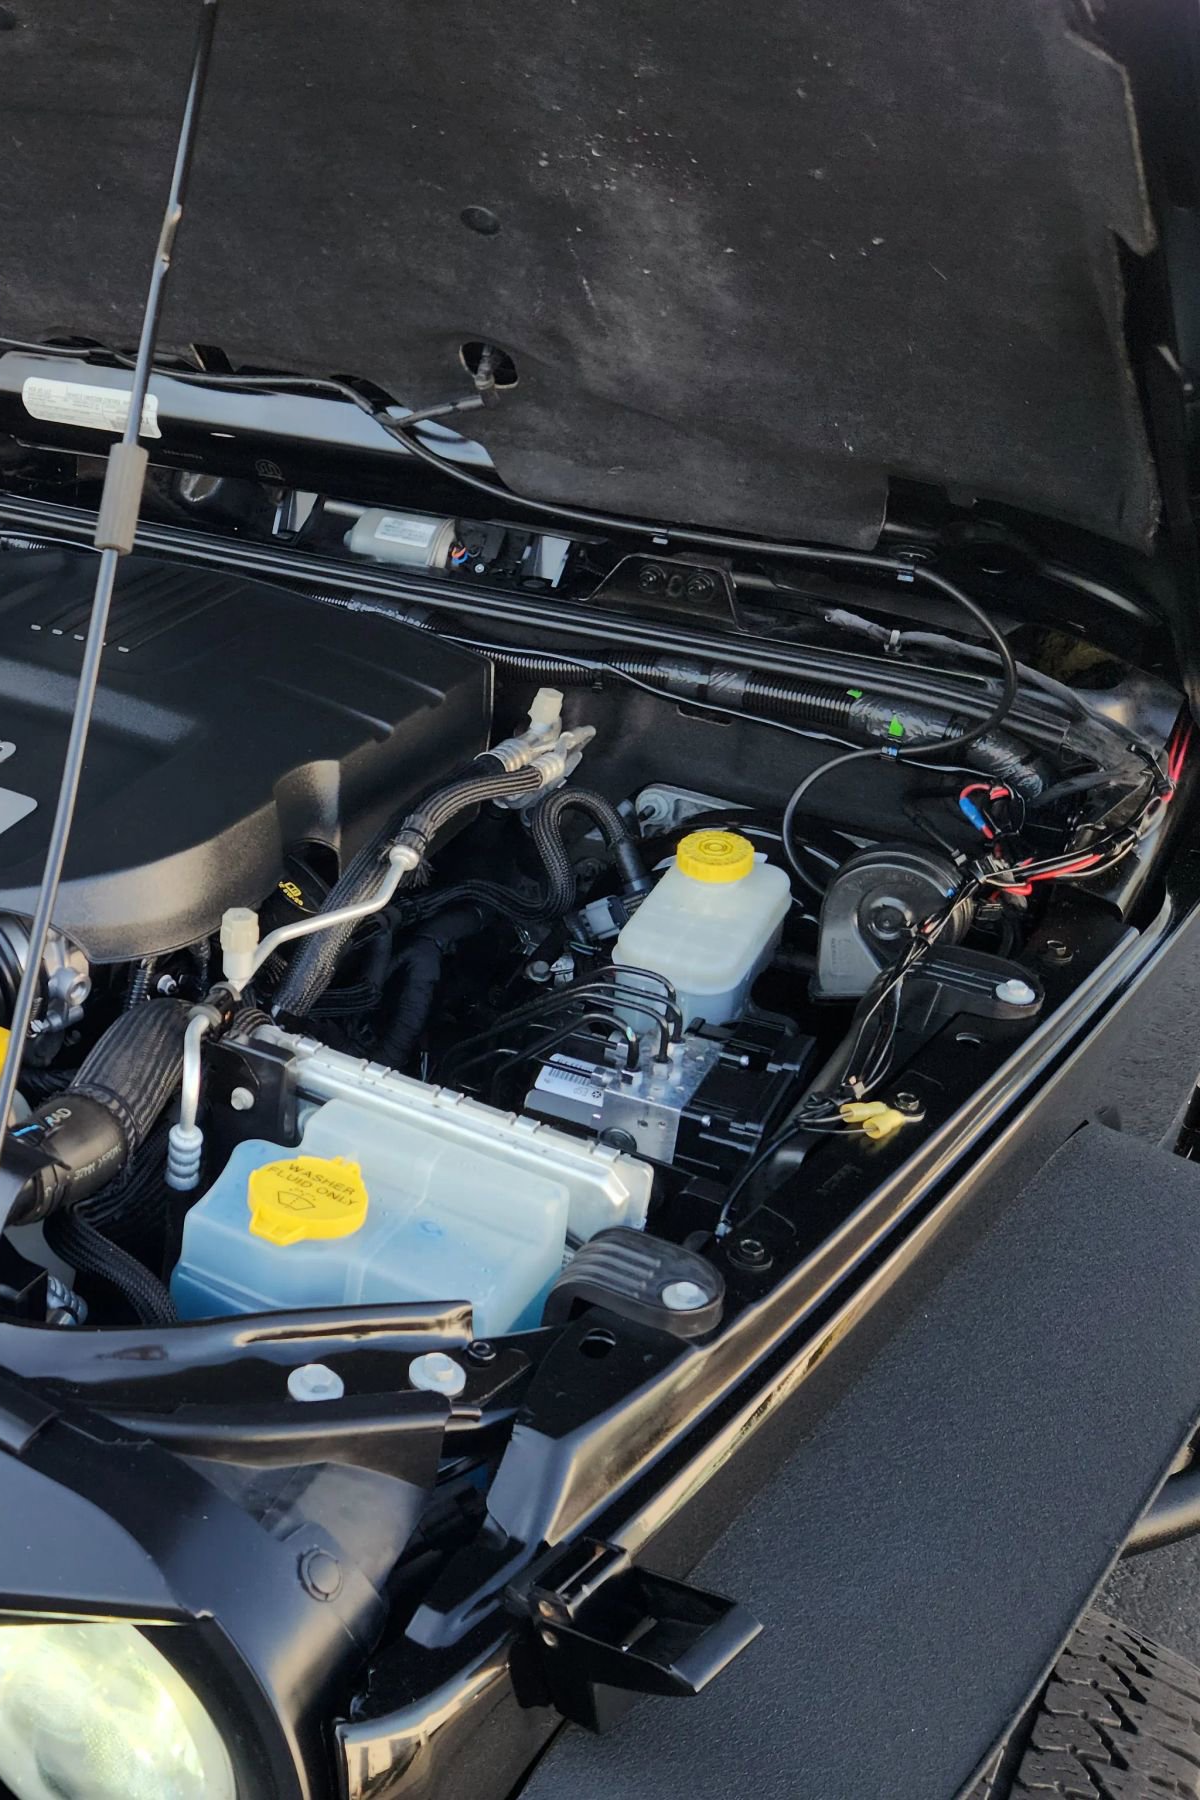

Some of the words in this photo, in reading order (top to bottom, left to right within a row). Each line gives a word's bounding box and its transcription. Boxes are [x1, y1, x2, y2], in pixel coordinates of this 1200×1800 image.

[267, 1165, 313, 1188] FLUID
[316, 1186, 359, 1206] ONLY
[289, 1163, 355, 1195] WASHER
